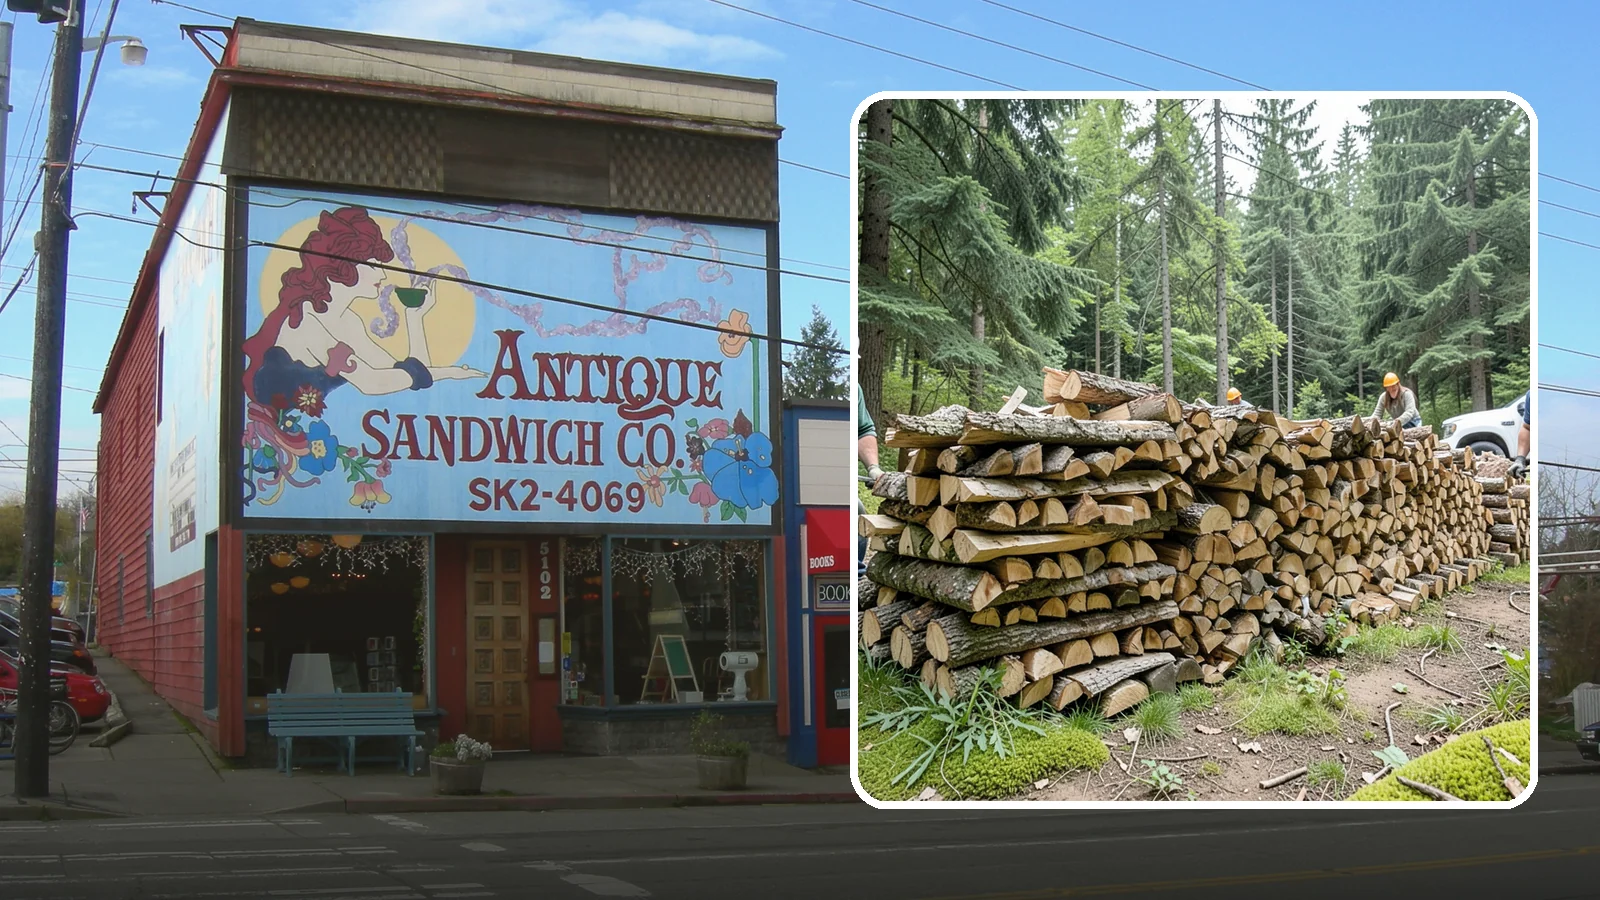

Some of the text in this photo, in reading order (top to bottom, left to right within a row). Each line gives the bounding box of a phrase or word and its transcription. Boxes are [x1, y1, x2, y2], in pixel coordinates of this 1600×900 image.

[475, 329, 724, 421] ANTIQUE
[360, 408, 686, 469] SANDWICH CO.
[468, 477, 646, 512] SK2-4069
[539, 541, 552, 600] 5102
[809, 555, 835, 569] BOOKS
